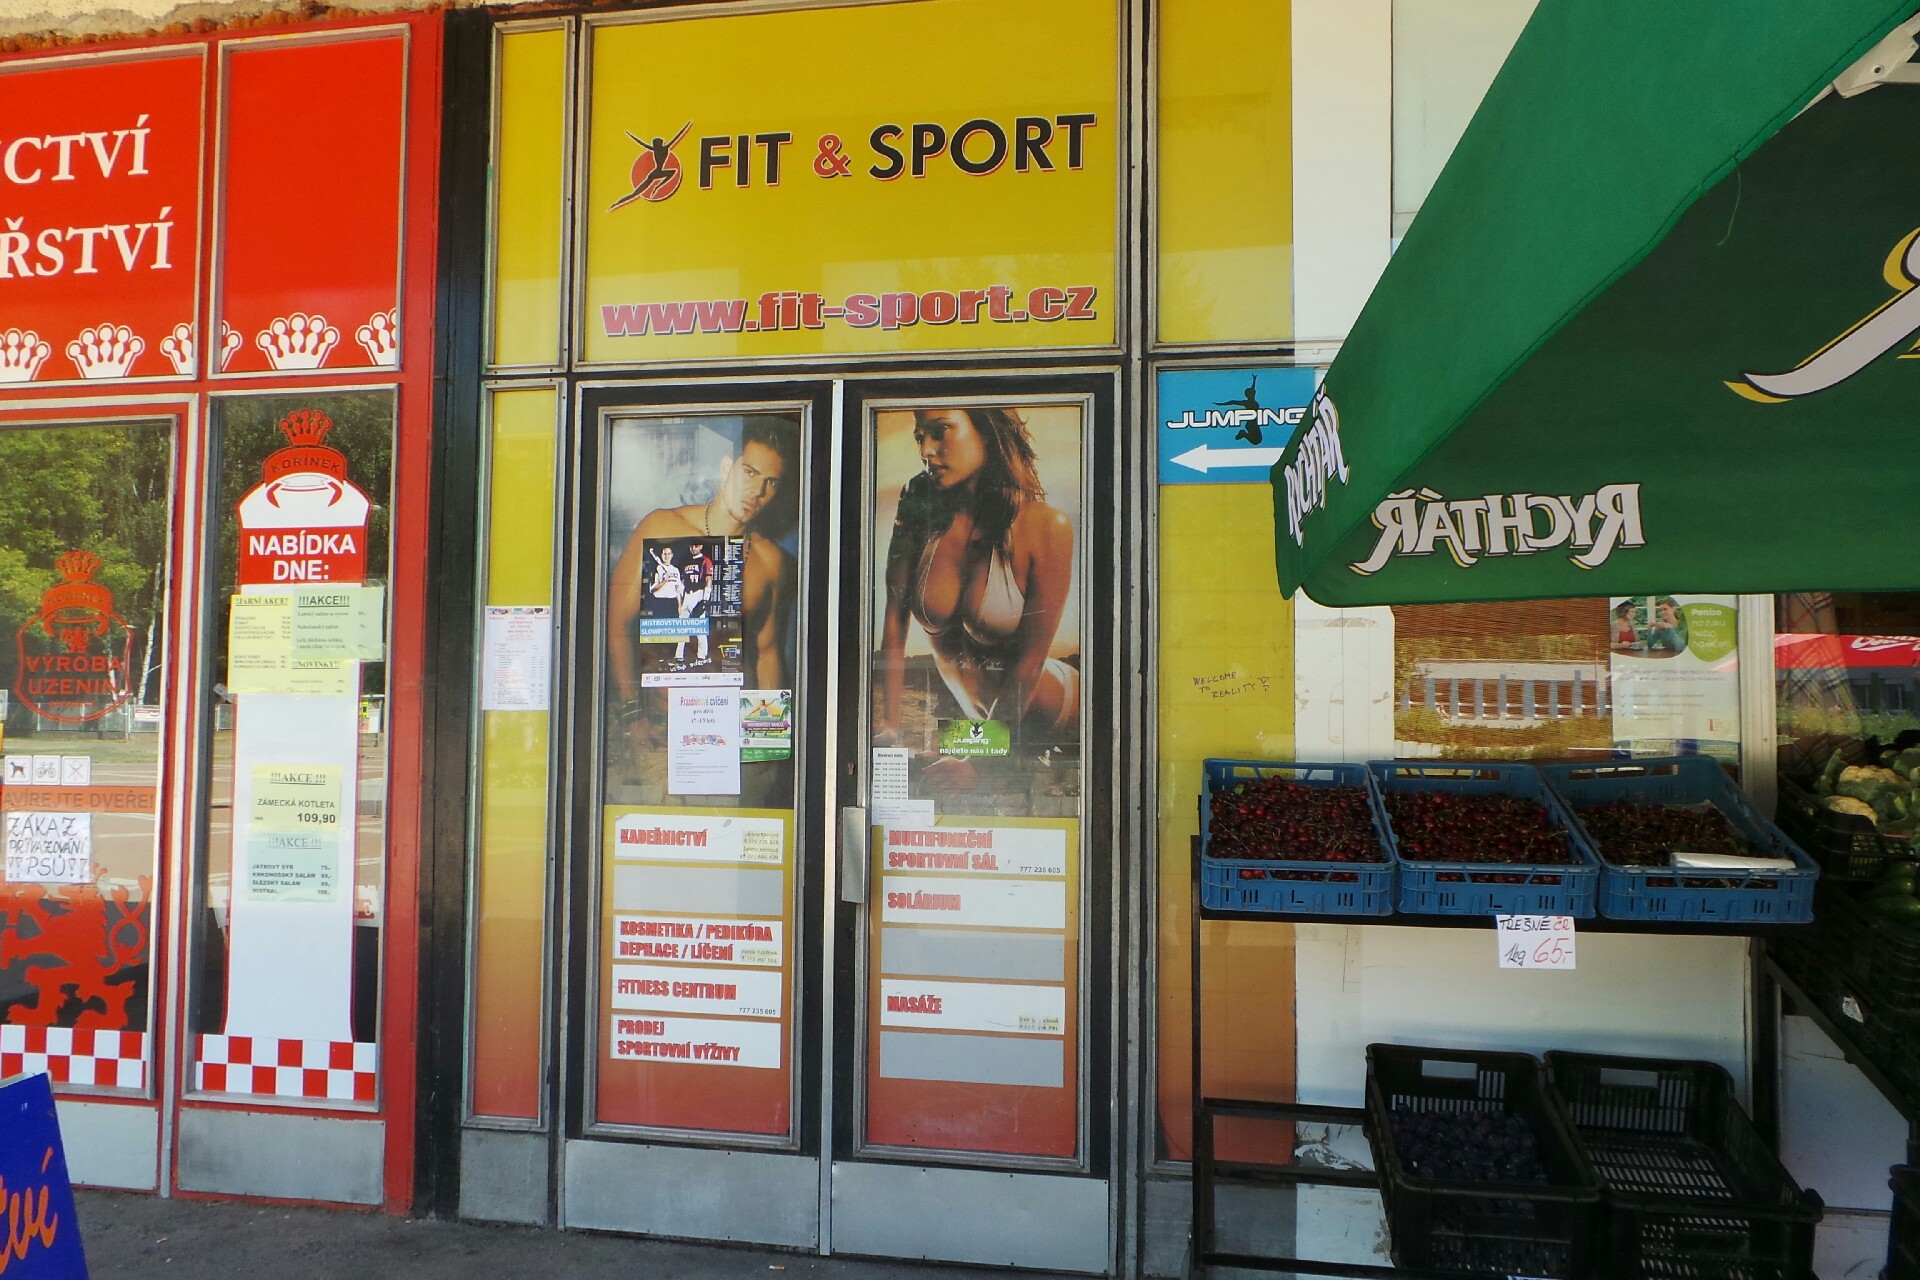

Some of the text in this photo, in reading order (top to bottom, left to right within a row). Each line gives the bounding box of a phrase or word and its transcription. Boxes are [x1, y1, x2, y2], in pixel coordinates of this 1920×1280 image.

[0, 113, 151, 185] CTVÍ
[700, 113, 1098, 190] FIT & SPORT
[600, 284, 1099, 338] www.fit-sport.cz
[1166, 406, 1307, 429] JUMPING
[249, 530, 356, 556] NABÍDKA
[273, 559, 329, 581] DNE:
[641, 619, 682, 627] MISTROVSTVÍ
[641, 627, 676, 635] SLOWPITCH
[1193, 672, 1237, 686] WELCOME
[1199, 685, 1211, 693] TO
[1211, 682, 1256, 699] REALITY
[940, 747, 969, 755] najdete
[990, 747, 1008, 756] tady
[257, 798, 336, 809] ZÁMECKÁ KOTLETA
[8, 814, 77, 838] ZÁKAZ
[297, 813, 336, 825] 109,90
[620, 827, 709, 847] KADEŘNICTVÍ
[888, 829, 993, 849] MULTIFUNKČNÍ
[888, 850, 999, 871] SPORTOVNÍ SÁL
[1034, 866, 1047, 874] 235
[888, 889, 962, 911] SOLÁRIUM
[620, 921, 774, 942] KOSMETIKA / PEDIKÚRA
[1553, 915, 1571, 932] ČR
[619, 942, 679, 959] DEPILACE
[681, 944, 689, 960] /
[690, 942, 734, 961] LÍČENÍ
[618, 979, 737, 1001] FITNESS CENTRUM
[752, 1007, 764, 1015] 235
[886, 994, 943, 1015] MASÁŽE
[617, 1020, 665, 1037] PRODEJ
[617, 1040, 740, 1062] SPORTOVNÍ VÝŽIVY
